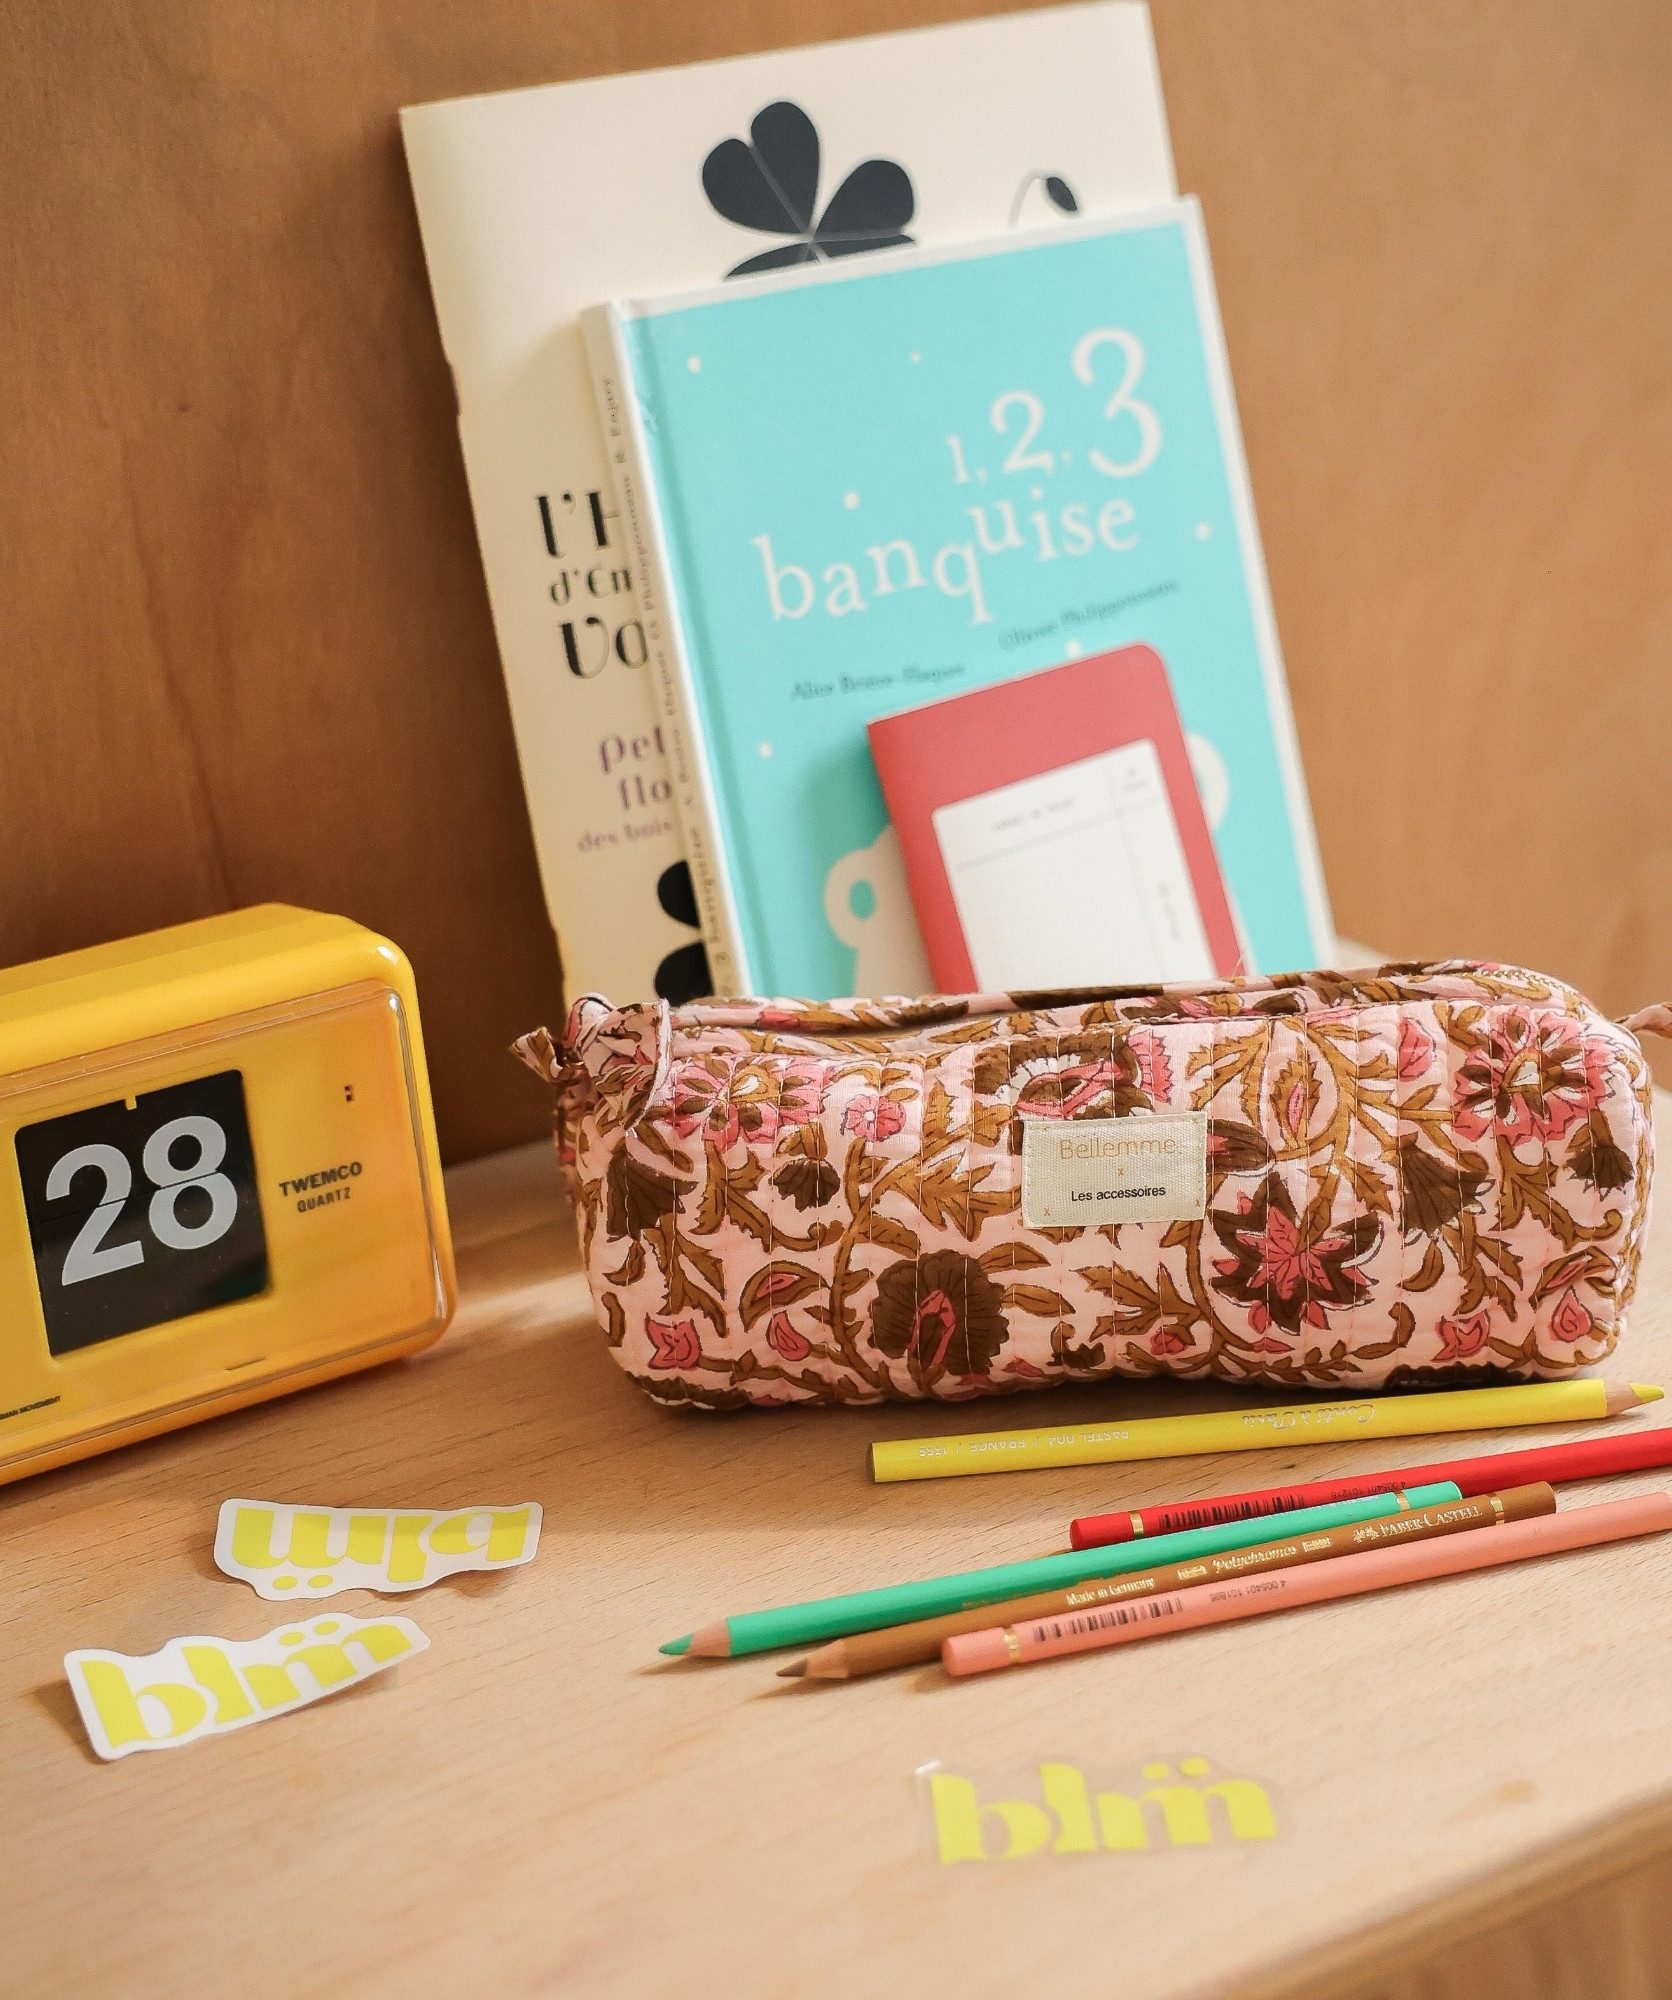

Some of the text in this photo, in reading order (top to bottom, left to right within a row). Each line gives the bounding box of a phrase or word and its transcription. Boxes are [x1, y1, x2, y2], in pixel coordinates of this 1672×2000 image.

[1071, 326, 1163, 478] 3
[751, 486, 1140, 626] banquise
[1059, 1136, 1177, 1160] Bellemme
[279, 1161, 363, 1196] TWEMCO
[46, 1115, 238, 1286] 28
[297, 1187, 351, 1212] QUARTZ
[1071, 1185, 1166, 1202] Les accessoires
[970, 1438, 1026, 1453] FRANCE
[1081, 1430, 1129, 1444] PASTEL
[1212, 1545, 1297, 1574] Polychromos
